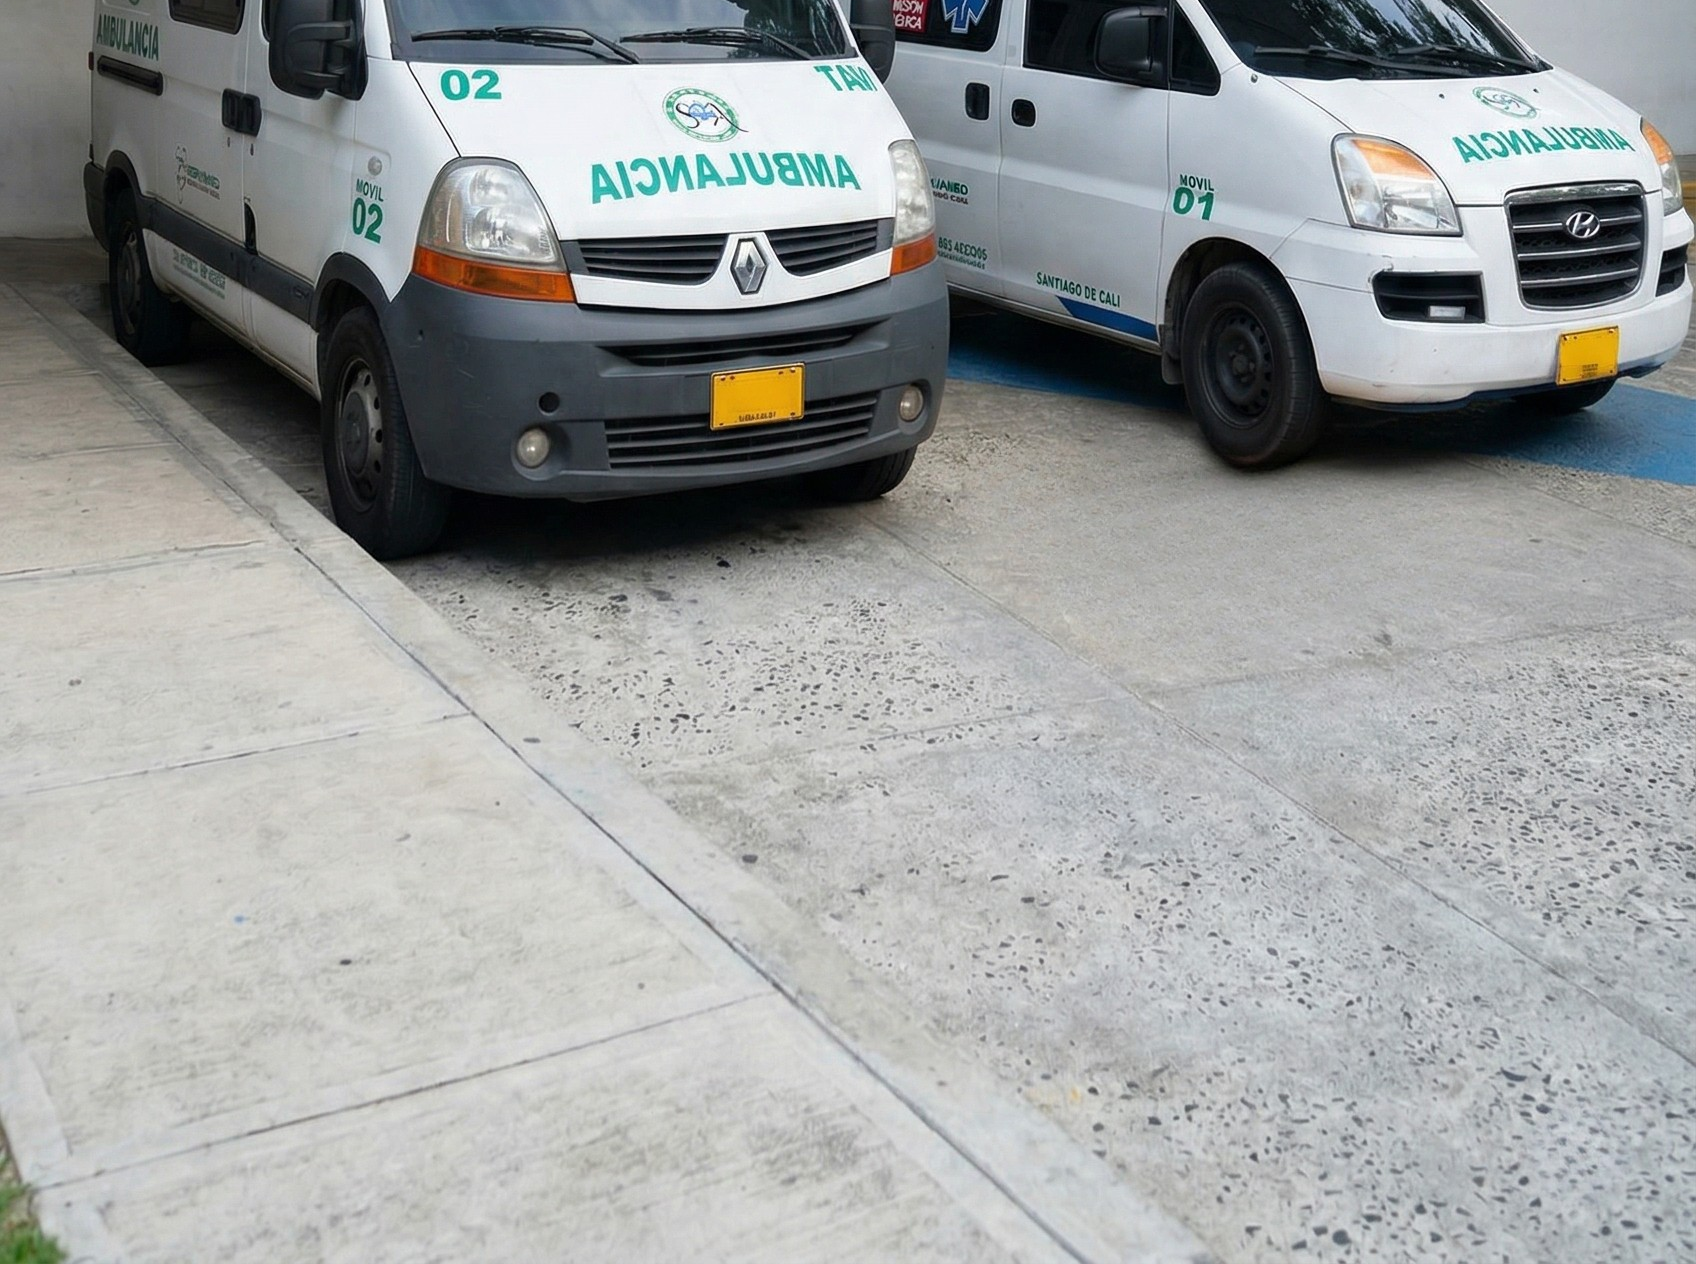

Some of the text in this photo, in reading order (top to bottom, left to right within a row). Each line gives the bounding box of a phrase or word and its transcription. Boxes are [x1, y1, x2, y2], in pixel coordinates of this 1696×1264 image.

[96, 13, 159, 61] AMBULANCIA
[440, 69, 502, 101] 02
[1180, 173, 1215, 192] MOVIL
[353, 197, 383, 244] 02
[1173, 186, 1214, 221] 01
[1036, 271, 1120, 308] SANTIAGO DE CALI
